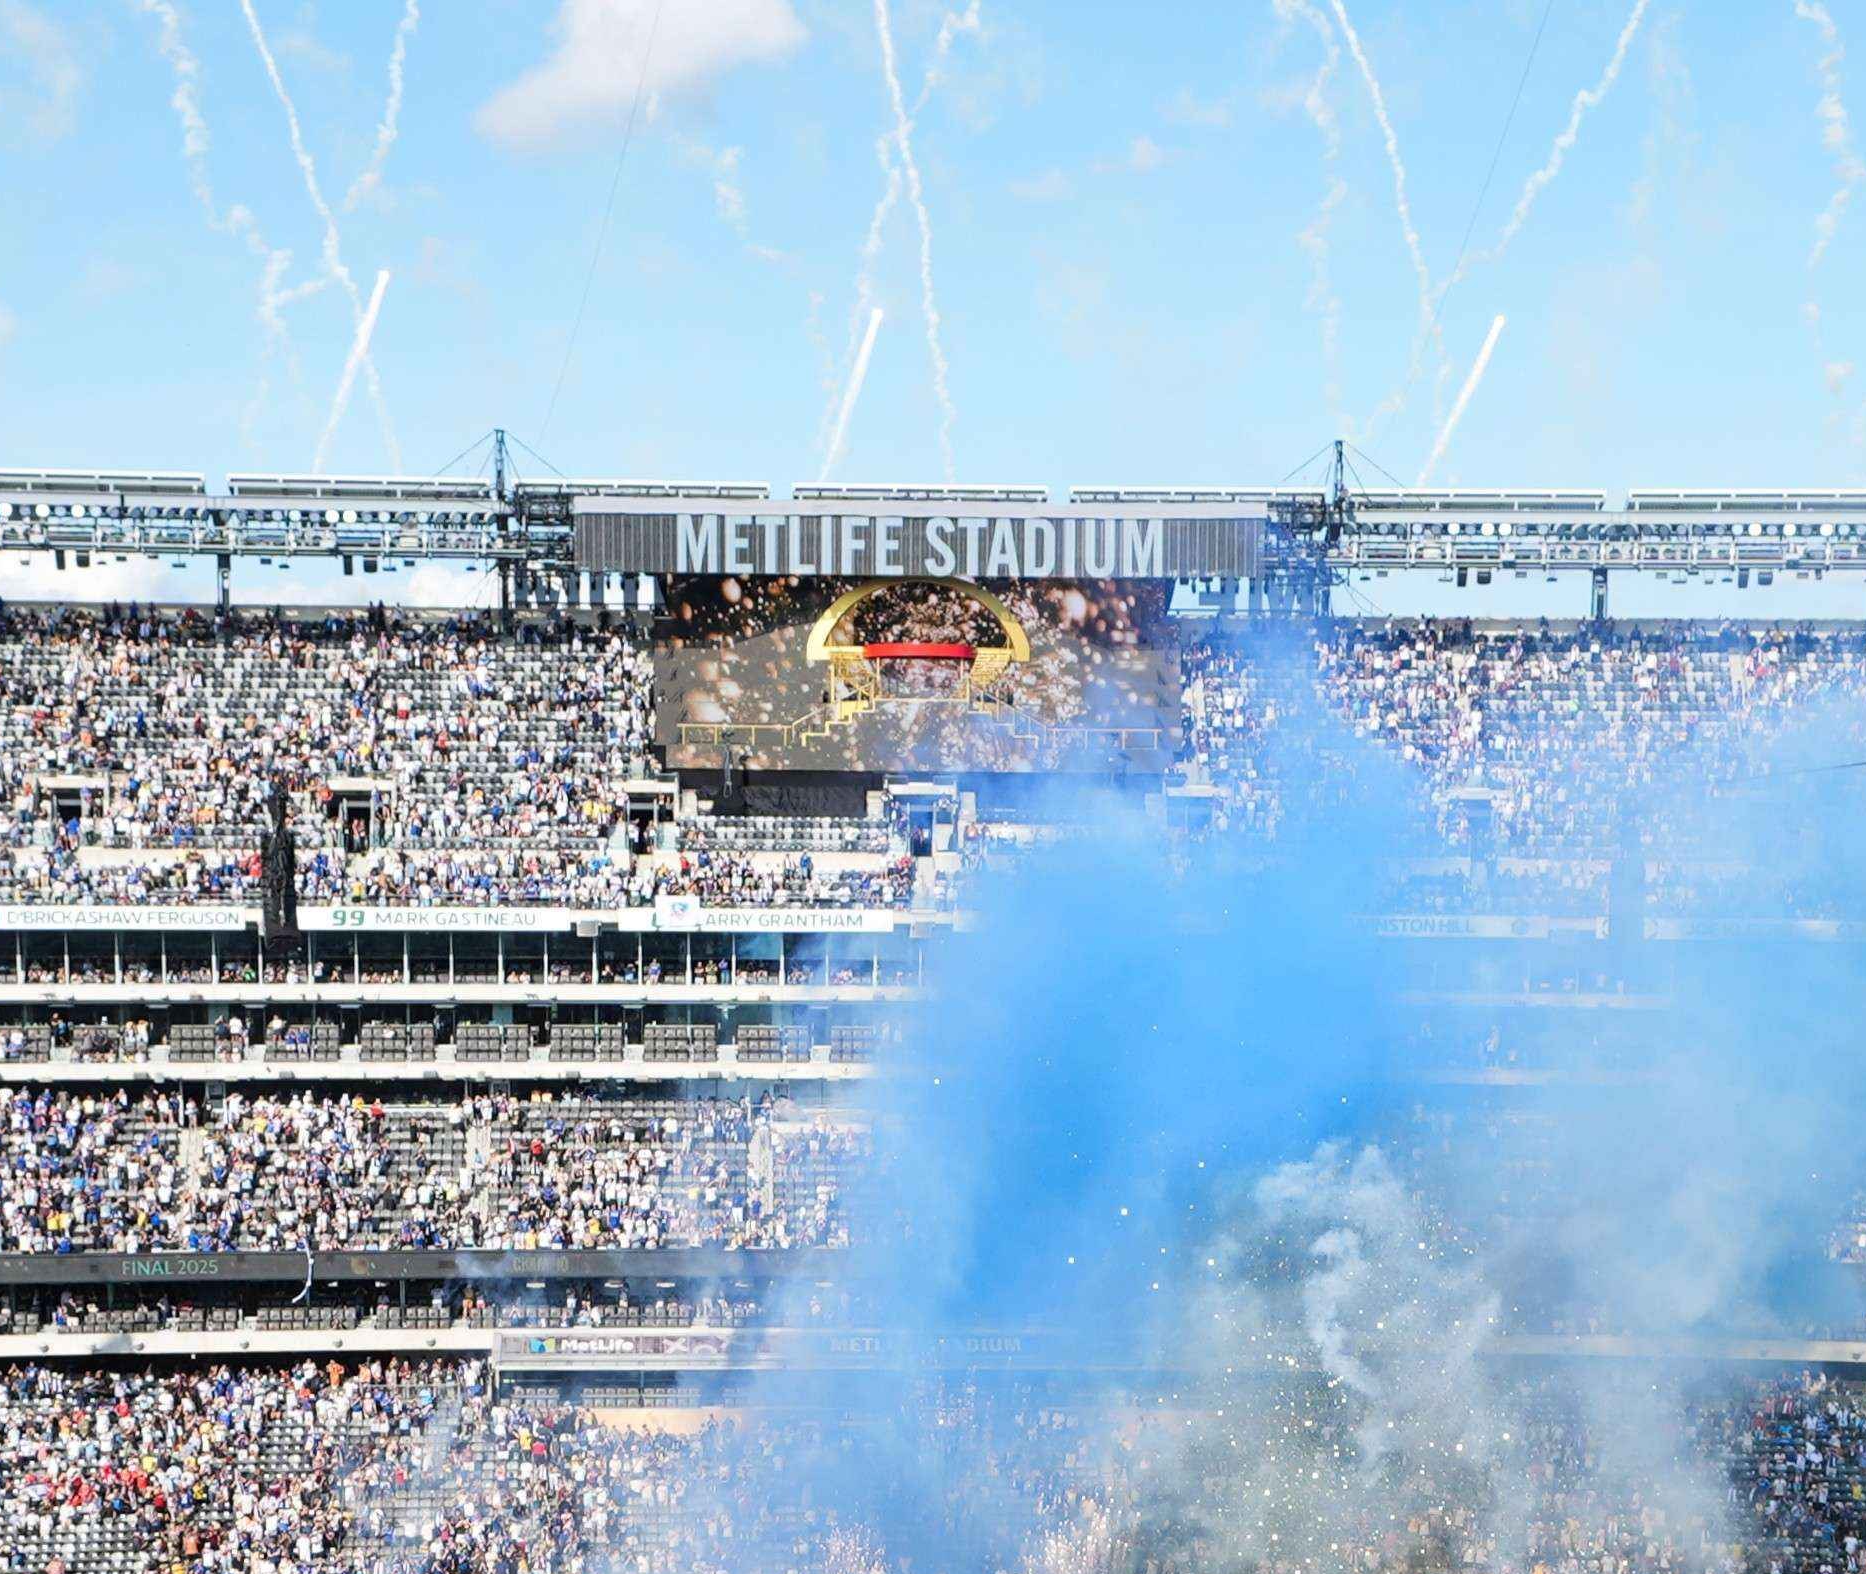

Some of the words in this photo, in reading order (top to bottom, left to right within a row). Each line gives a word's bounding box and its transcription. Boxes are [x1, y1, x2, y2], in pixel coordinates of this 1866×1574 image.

[675, 513, 903, 577] METLIFE
[922, 515, 1162, 578] STADIUM
[146, 910, 240, 925] FERGUSON
[332, 910, 366, 926] 99
[375, 911, 432, 926] MARK
[435, 911, 538, 926] GASTINEAU
[704, 913, 752, 927] ARRY
[757, 913, 865, 927] GRANTHAM
[122, 1259, 175, 1276] FINAL
[178, 1259, 218, 1275] 2025
[561, 1337, 634, 1352] MetLife
